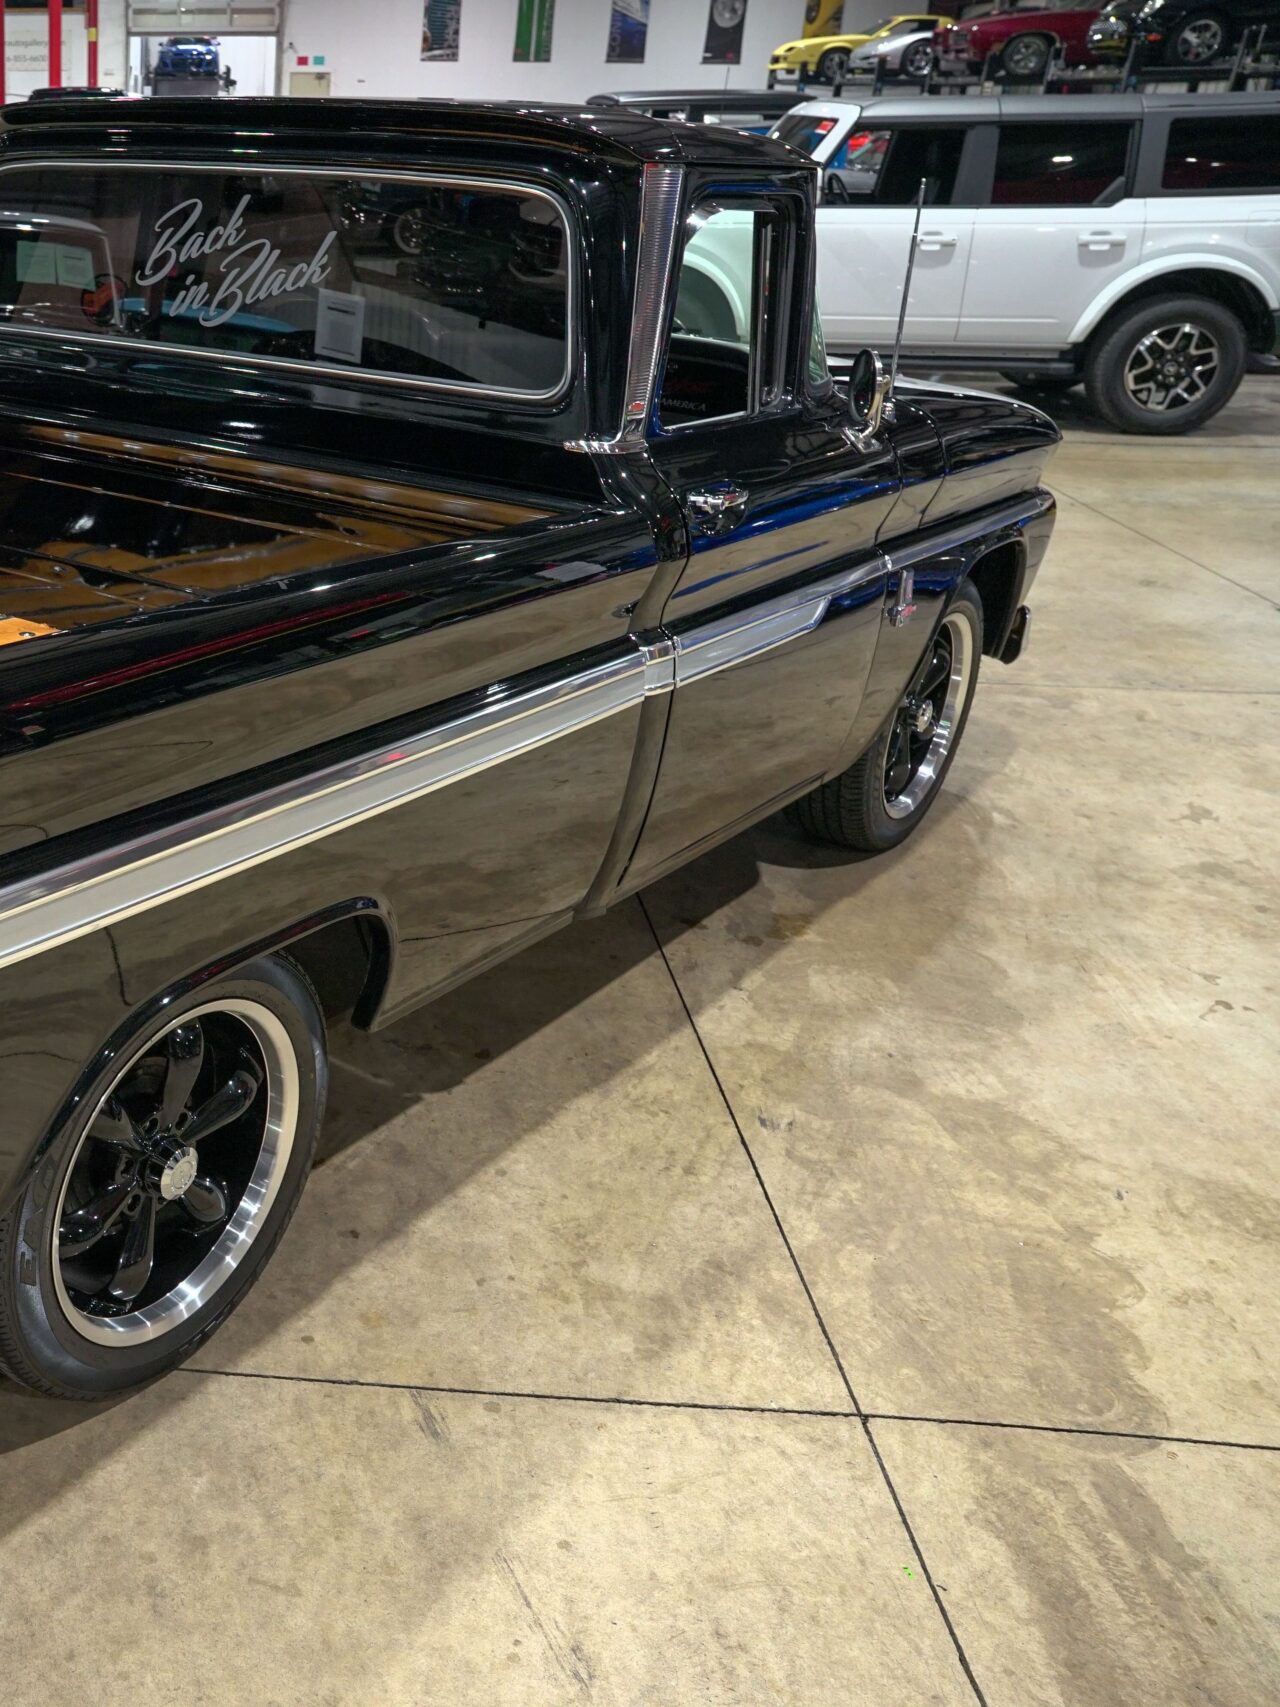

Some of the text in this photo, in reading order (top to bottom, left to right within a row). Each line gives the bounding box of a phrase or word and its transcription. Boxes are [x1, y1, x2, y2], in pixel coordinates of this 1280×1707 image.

[135, 194, 251, 286] Back
[170, 230, 337, 327] in Black
